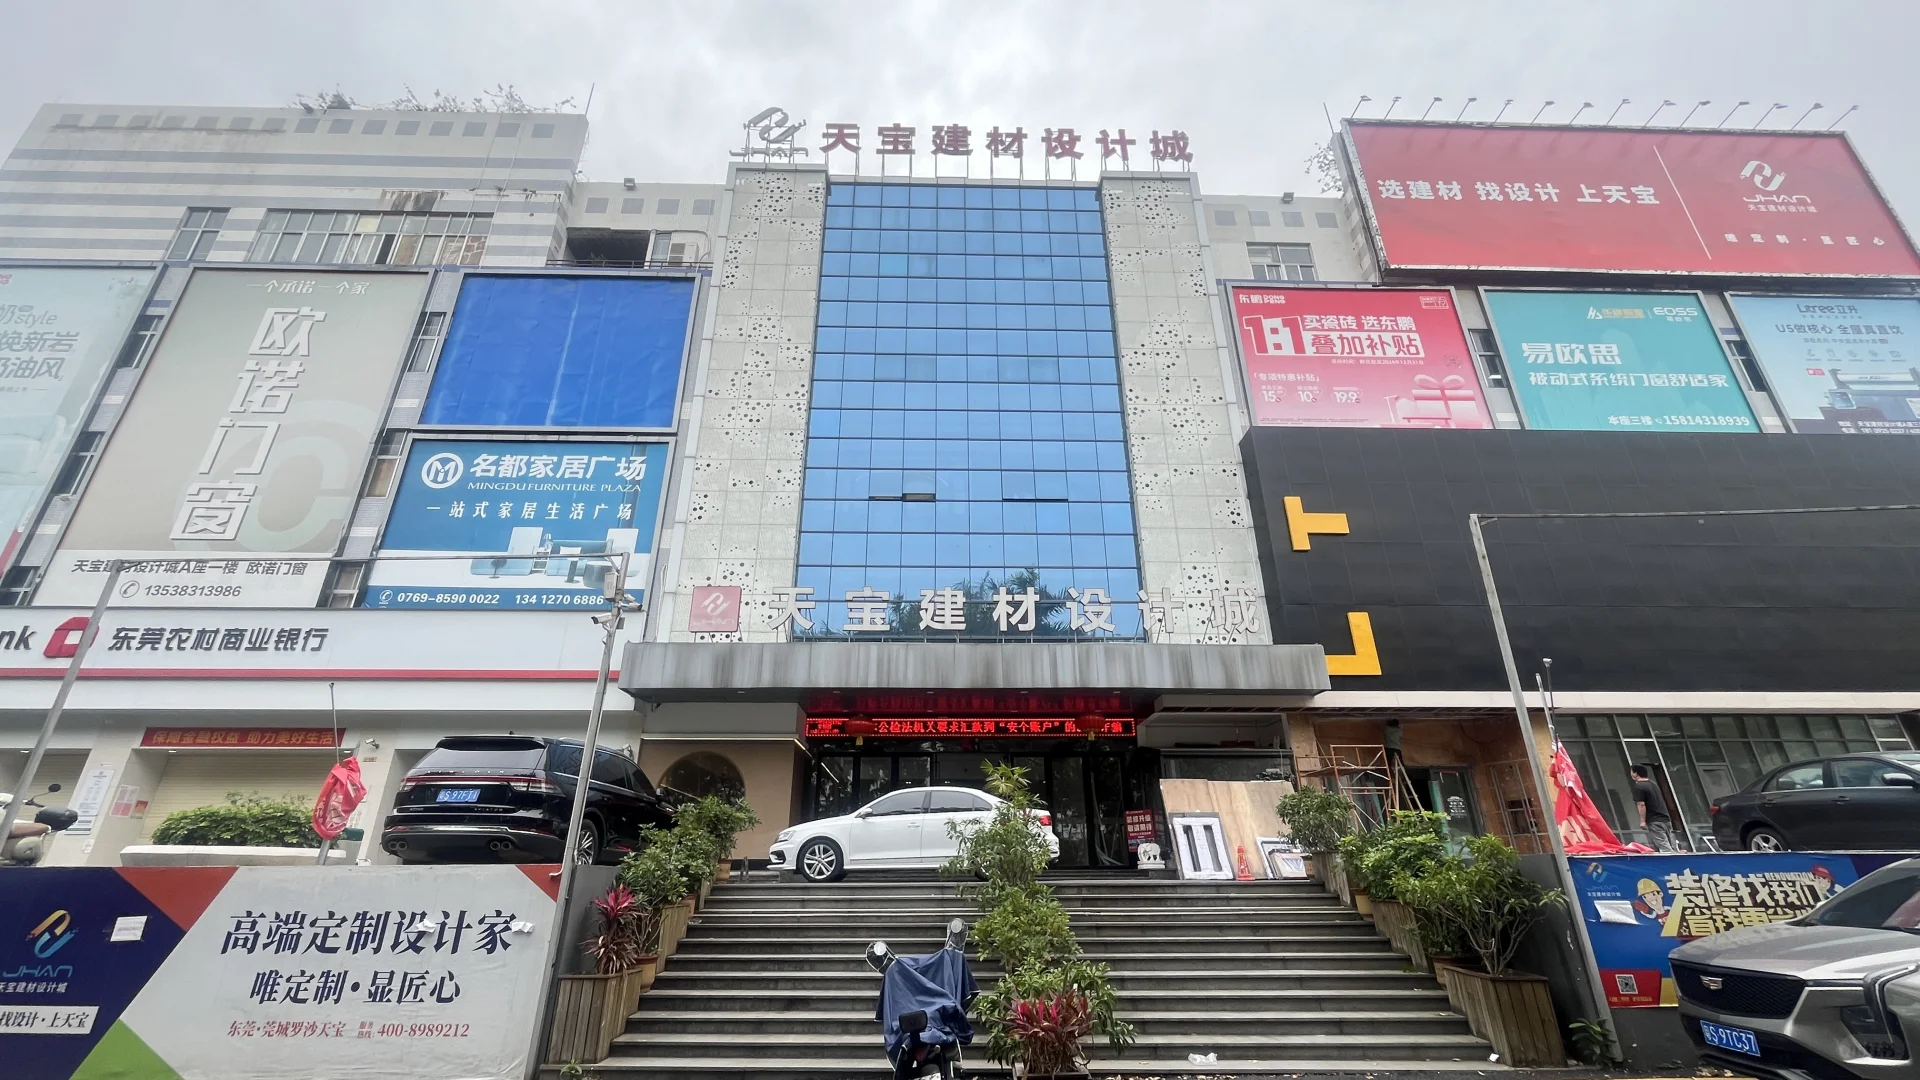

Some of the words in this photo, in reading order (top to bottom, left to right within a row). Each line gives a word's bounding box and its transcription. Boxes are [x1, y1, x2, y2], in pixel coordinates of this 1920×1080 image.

[819, 122, 1194, 163] 天宝建材设计城
[1376, 179, 1464, 200] 选建材
[1476, 181, 1560, 203] 找设计
[1576, 184, 1661, 205] 上天宝
[246, 278, 371, 296] 一个承诺一个家
[15, 310, 58, 328] style
[1653, 307, 1698, 316] EOSS
[1303, 315, 1358, 330] 买瓷砖
[1361, 316, 1417, 331] 选东鹏
[1311, 333, 1421, 355] 叠加补贴
[1521, 342, 1623, 365] 易欧思
[1529, 371, 1729, 389] 被动式系统门窗舒适家
[169, 306, 327, 541] 欧诺门窗
[1663, 415, 1750, 426] 15814318939
[469, 454, 647, 480] 名都家居广场
[467, 482, 526, 492] MINGDU
[528, 483, 597, 492] FURNITURE
[600, 484, 642, 492] PLAZA
[426, 501, 632, 520] 一站式家居生活广场
[245, 561, 308, 576] 欧诺门窗
[144, 585, 242, 597] 13538313986
[397, 593, 468, 604] 0769-8590
[469, 594, 500, 605] 0022
[515, 594, 537, 605] 134
[541, 594, 571, 605] 1270
[573, 594, 605, 605] 6886
[767, 586, 1261, 635] 天宝建材设计城
[107, 627, 329, 652] 东莞农村商业银行
[153, 730, 239, 744] 保障金融权益
[246, 731, 335, 745] 助力美好生活
[1663, 868, 1821, 910] 装修找我们
[220, 910, 517, 955] 高端定制设计家
[377, 1023, 470, 1037] 400-8989212
